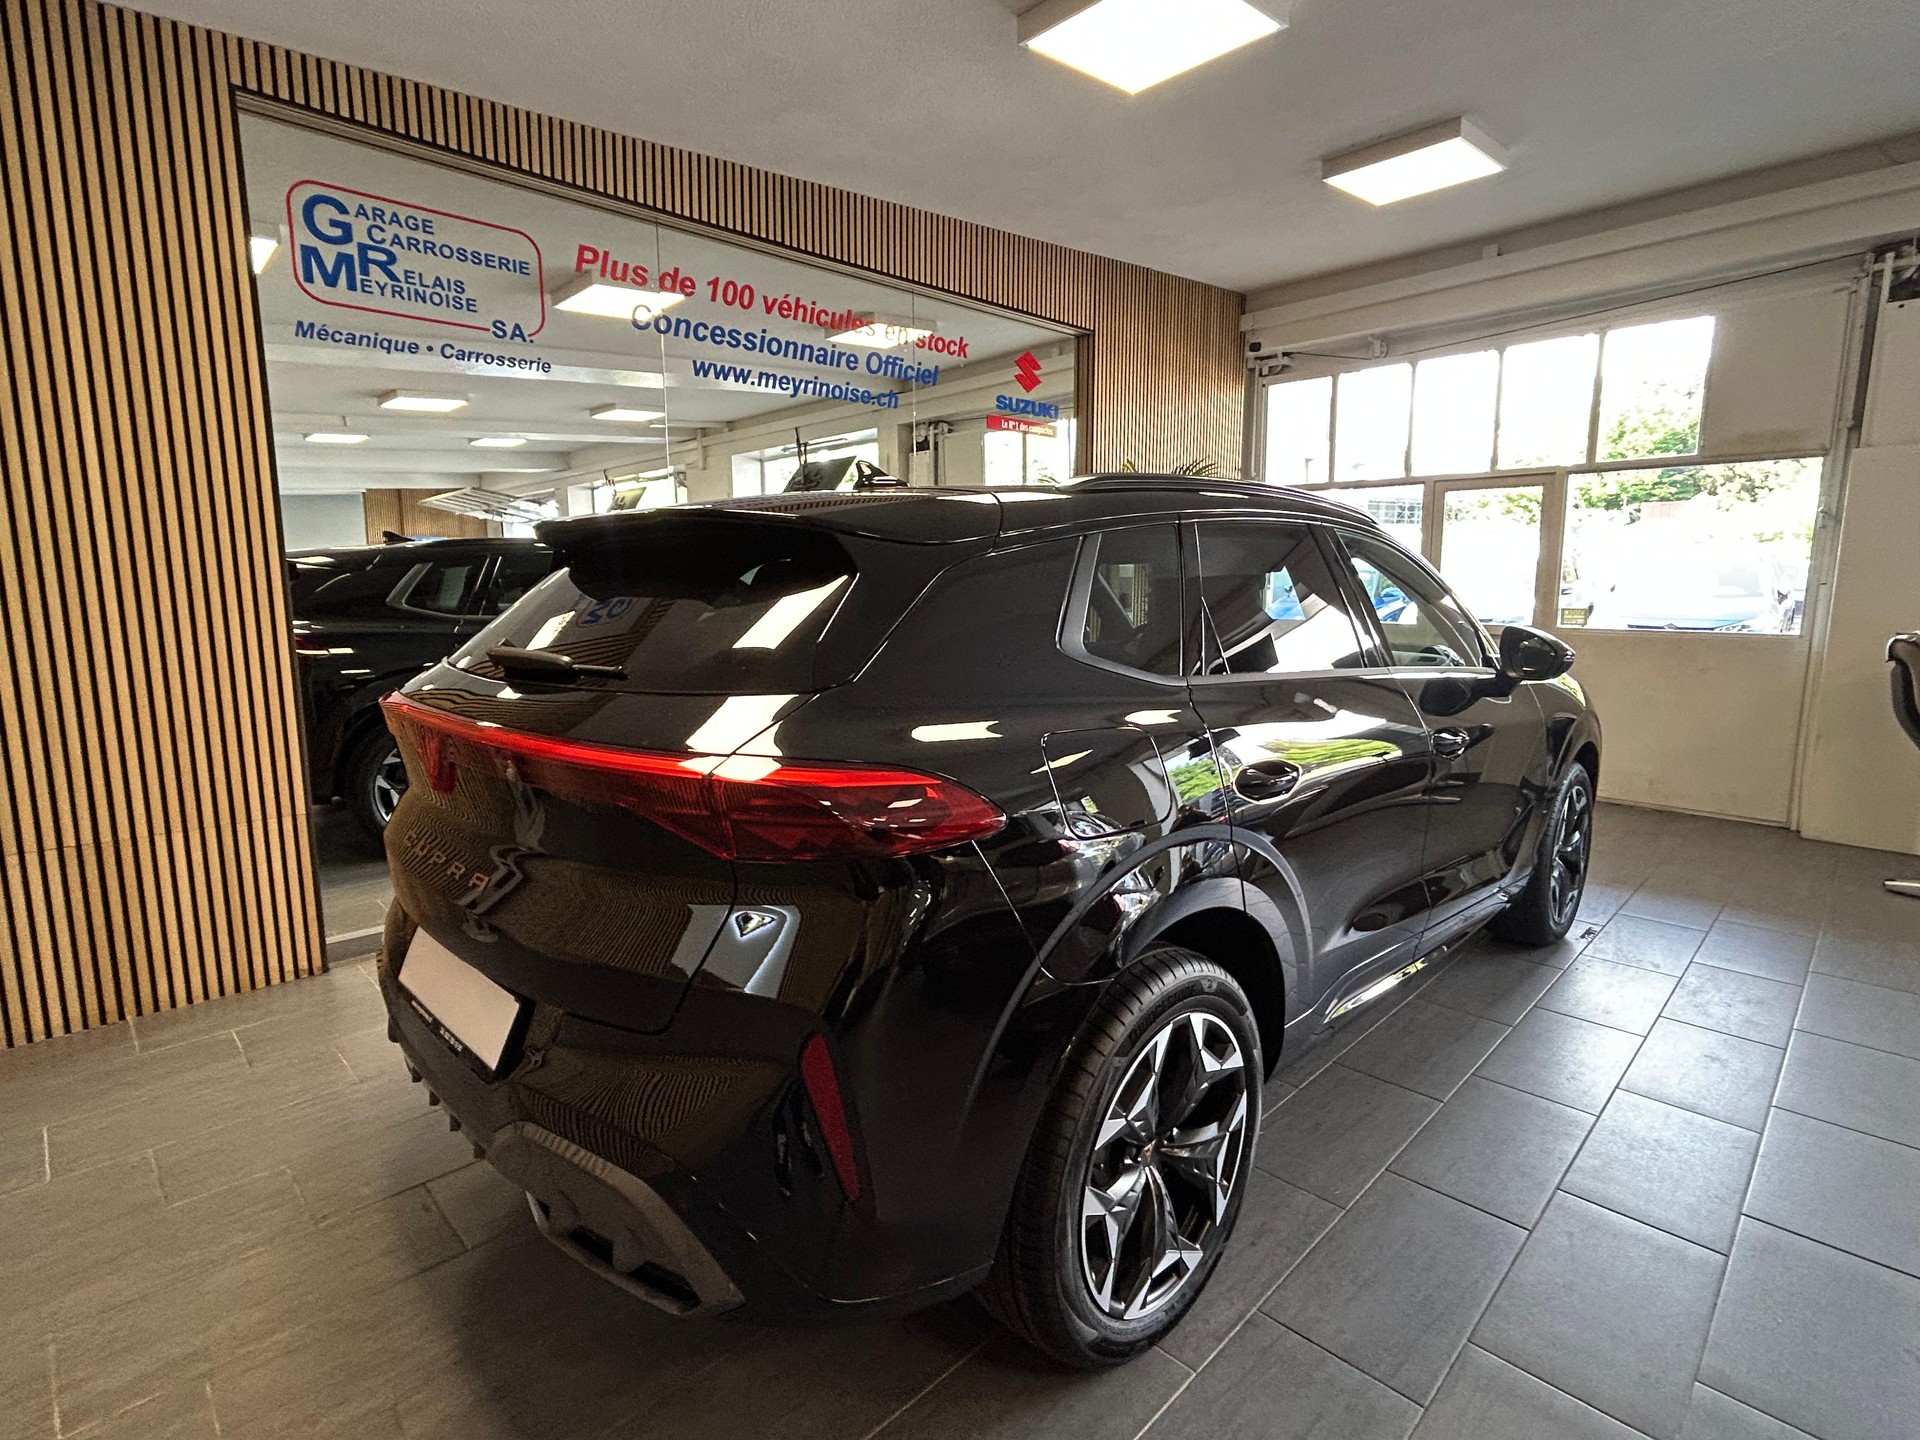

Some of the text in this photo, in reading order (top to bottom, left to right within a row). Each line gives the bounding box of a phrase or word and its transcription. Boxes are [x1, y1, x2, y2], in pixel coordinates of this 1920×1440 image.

[366, 223, 531, 276] CARROSSERIE
[575, 243, 648, 288] Plus
[659, 266, 696, 297] de
[707, 277, 755, 310] 100
[763, 294, 875, 336] véhicules
[915, 333, 970, 359] stock
[294, 320, 552, 374] Mécanique Carrosserie
[630, 304, 940, 386] Concessionnaire Officiel
[692, 359, 899, 410] www.meyrinoise.ch
[995, 394, 1060, 420] SUZUKI
[403, 831, 490, 892] CUPRA
